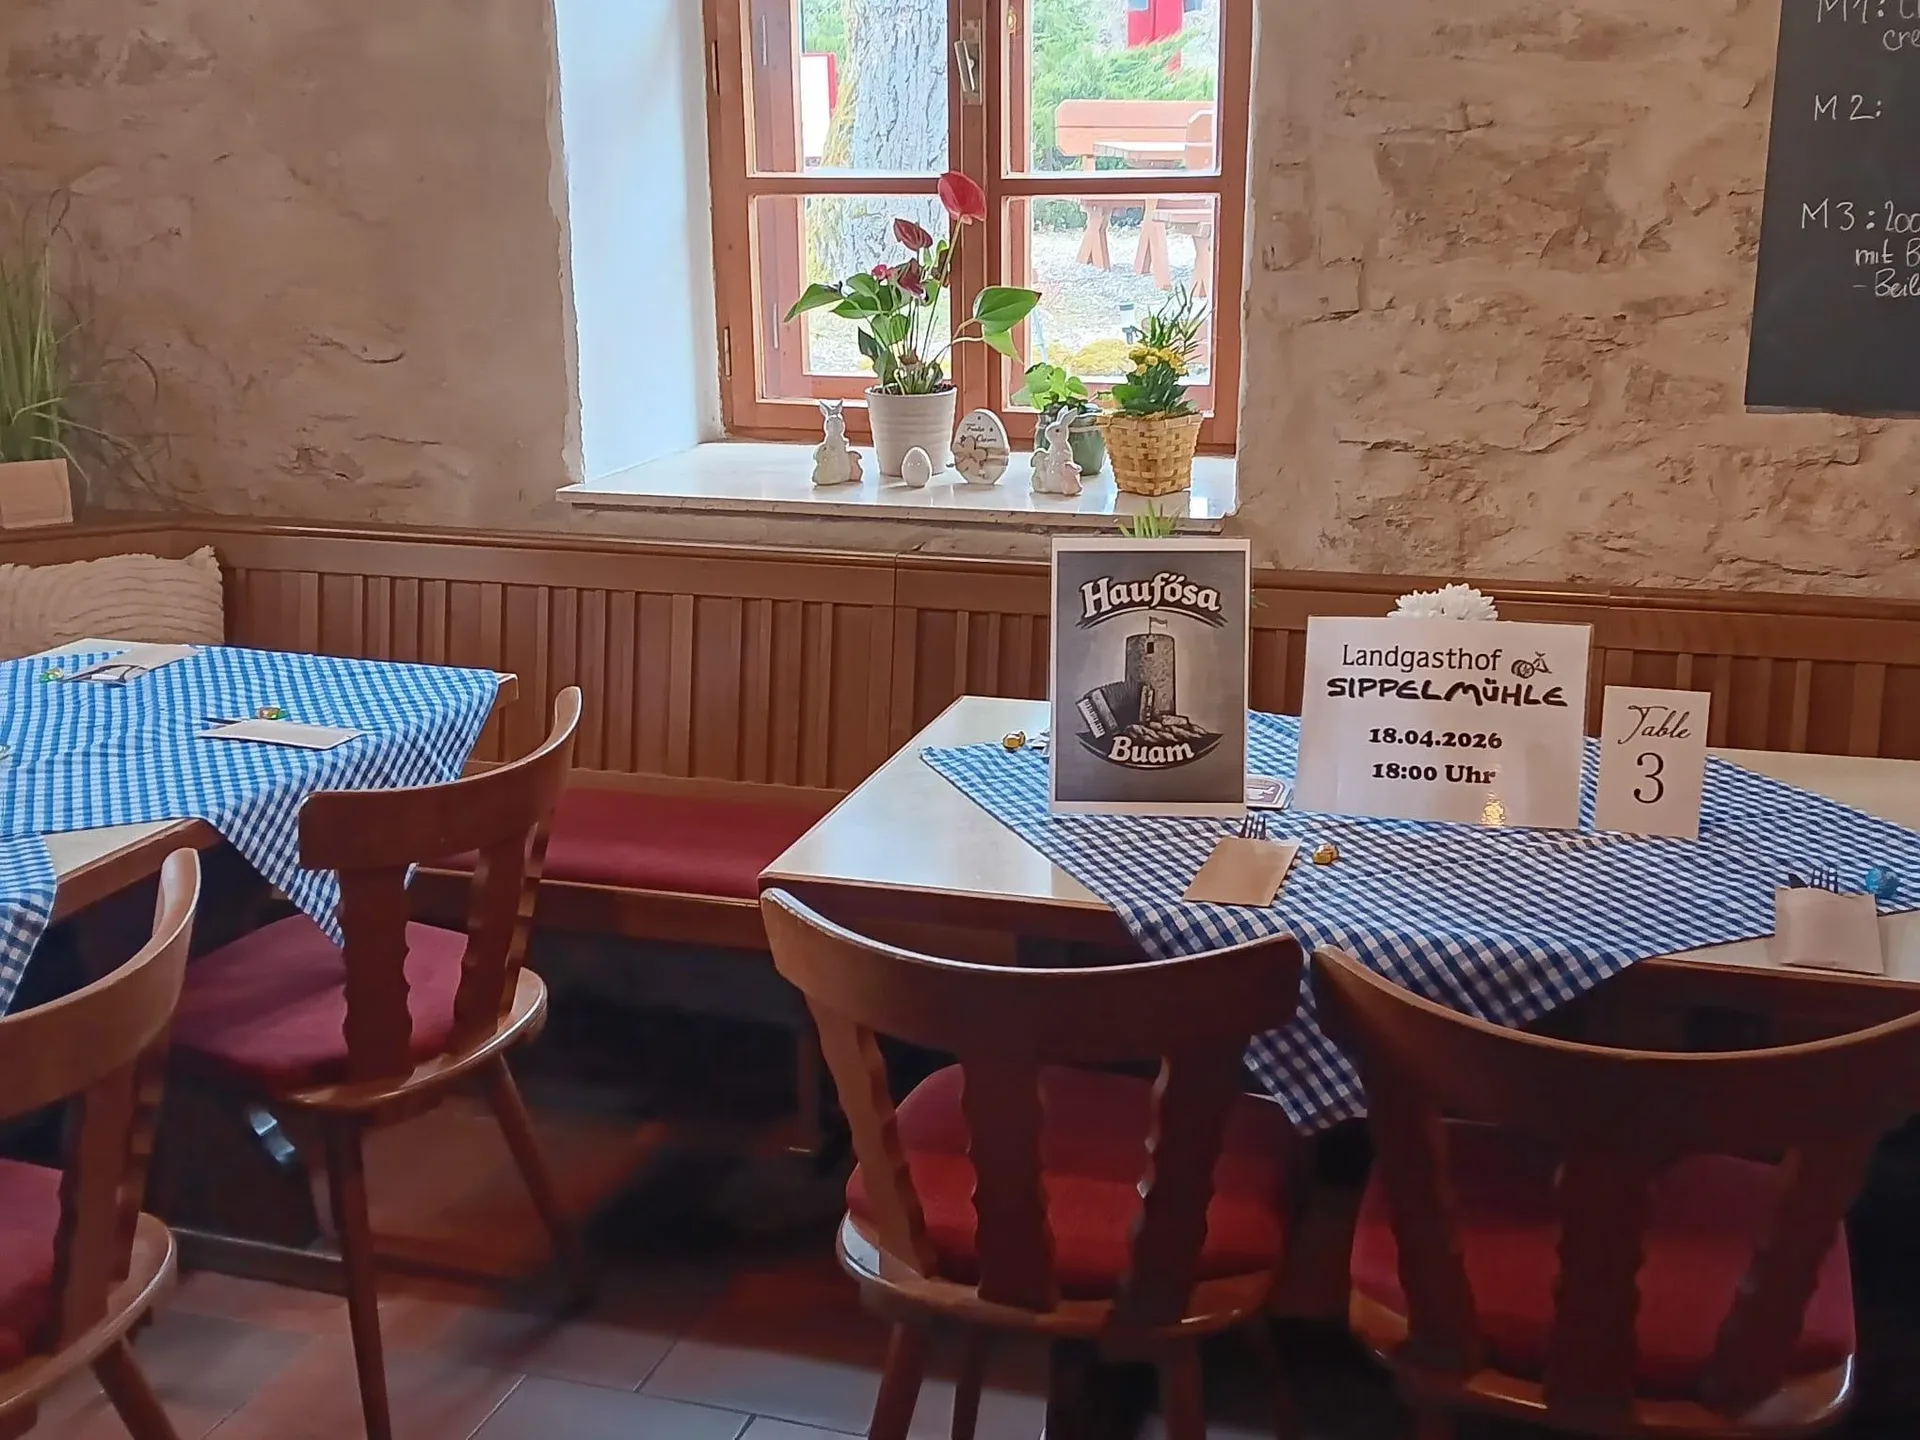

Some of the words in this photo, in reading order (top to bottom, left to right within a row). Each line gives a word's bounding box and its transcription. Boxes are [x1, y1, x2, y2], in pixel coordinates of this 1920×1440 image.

[1855, 238, 1895, 266] mit
[1342, 644, 1503, 673] Landgasthof
[1326, 678, 1568, 706] SIPPELMÜHLE
[1368, 727, 1503, 750] 18.04.2026
[1617, 704, 1693, 745] Table
[1108, 735, 1195, 764] Buam
[1371, 762, 1438, 782] 18:00
[1445, 764, 1496, 785] Uhr
[1633, 752, 1665, 804] 3
